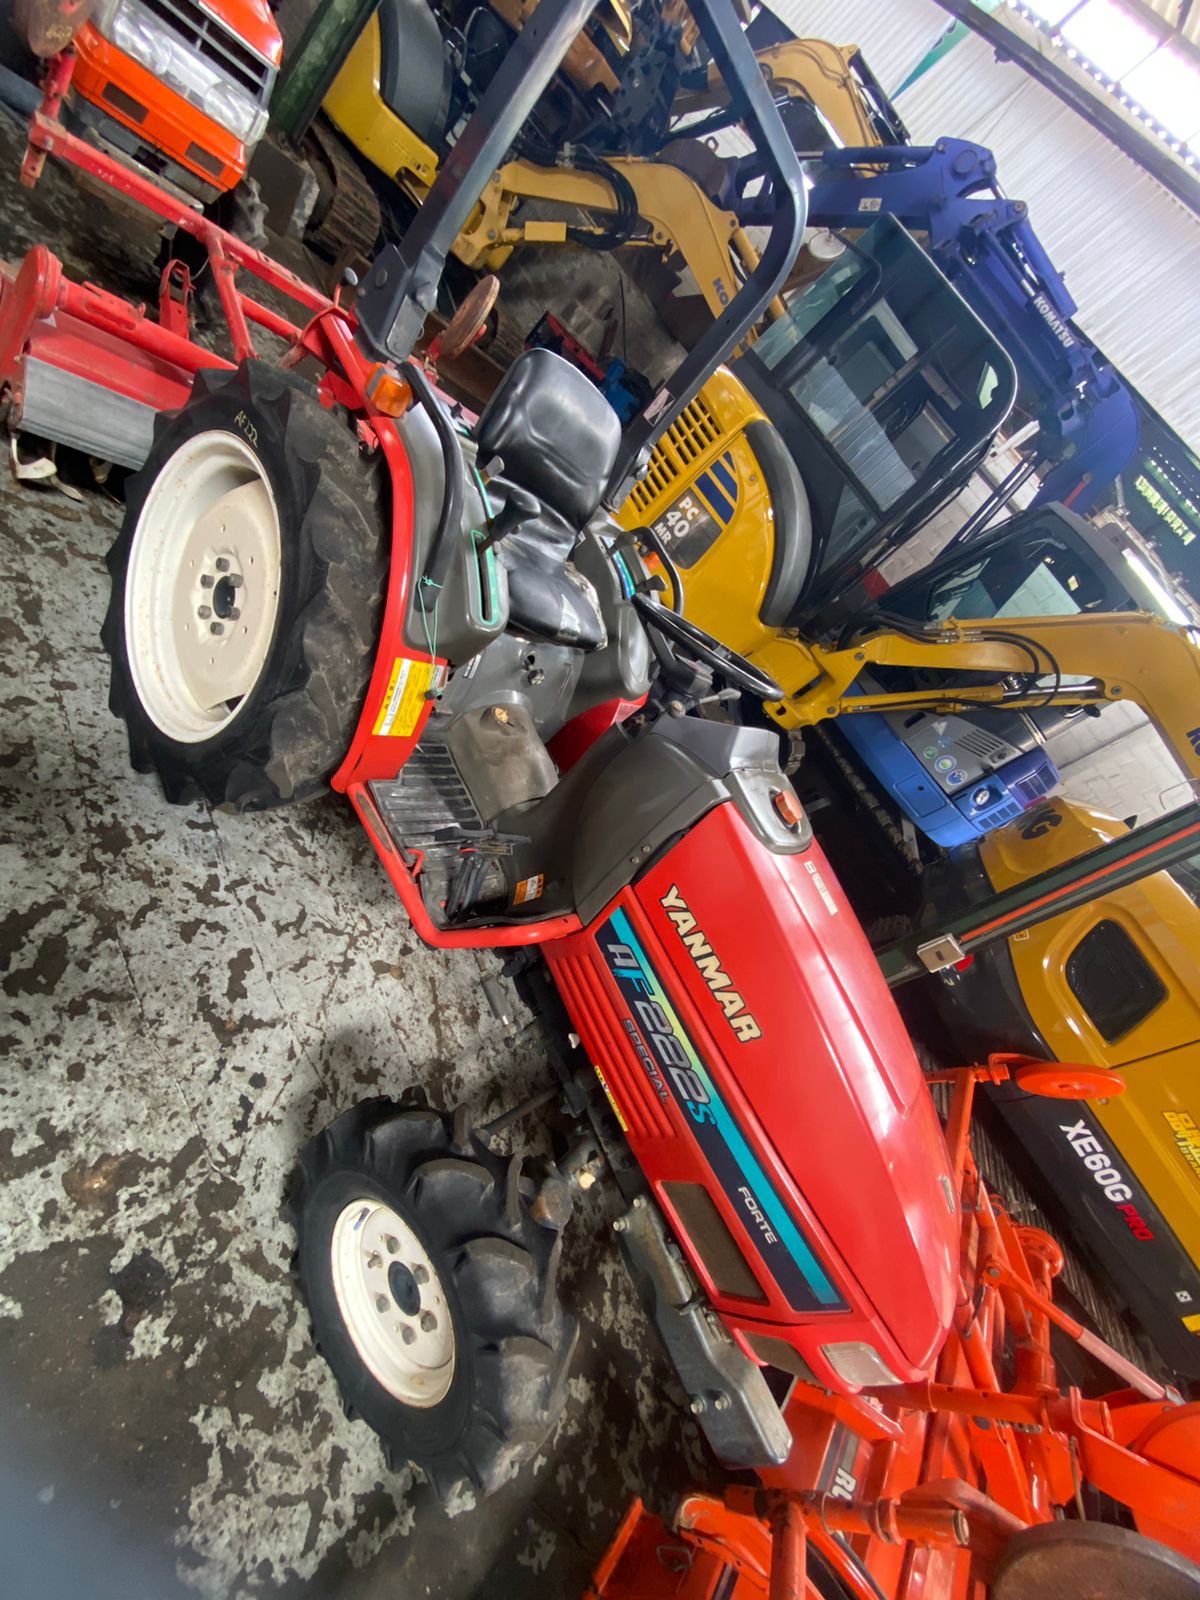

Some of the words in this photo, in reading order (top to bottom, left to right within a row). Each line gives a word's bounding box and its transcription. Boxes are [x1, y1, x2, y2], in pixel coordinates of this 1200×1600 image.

[1033, 296, 1074, 348] KOMATSU
[654, 522, 672, 545] MR
[666, 511, 690, 538] 40
[679, 496, 699, 520] PC
[660, 883, 762, 1043] YANMAR
[622, 1017, 669, 1105] SPECIAL
[1059, 1119, 1133, 1202] XE60G
[738, 1186, 778, 1245] FORTE
[1115, 1203, 1154, 1241] PRO
